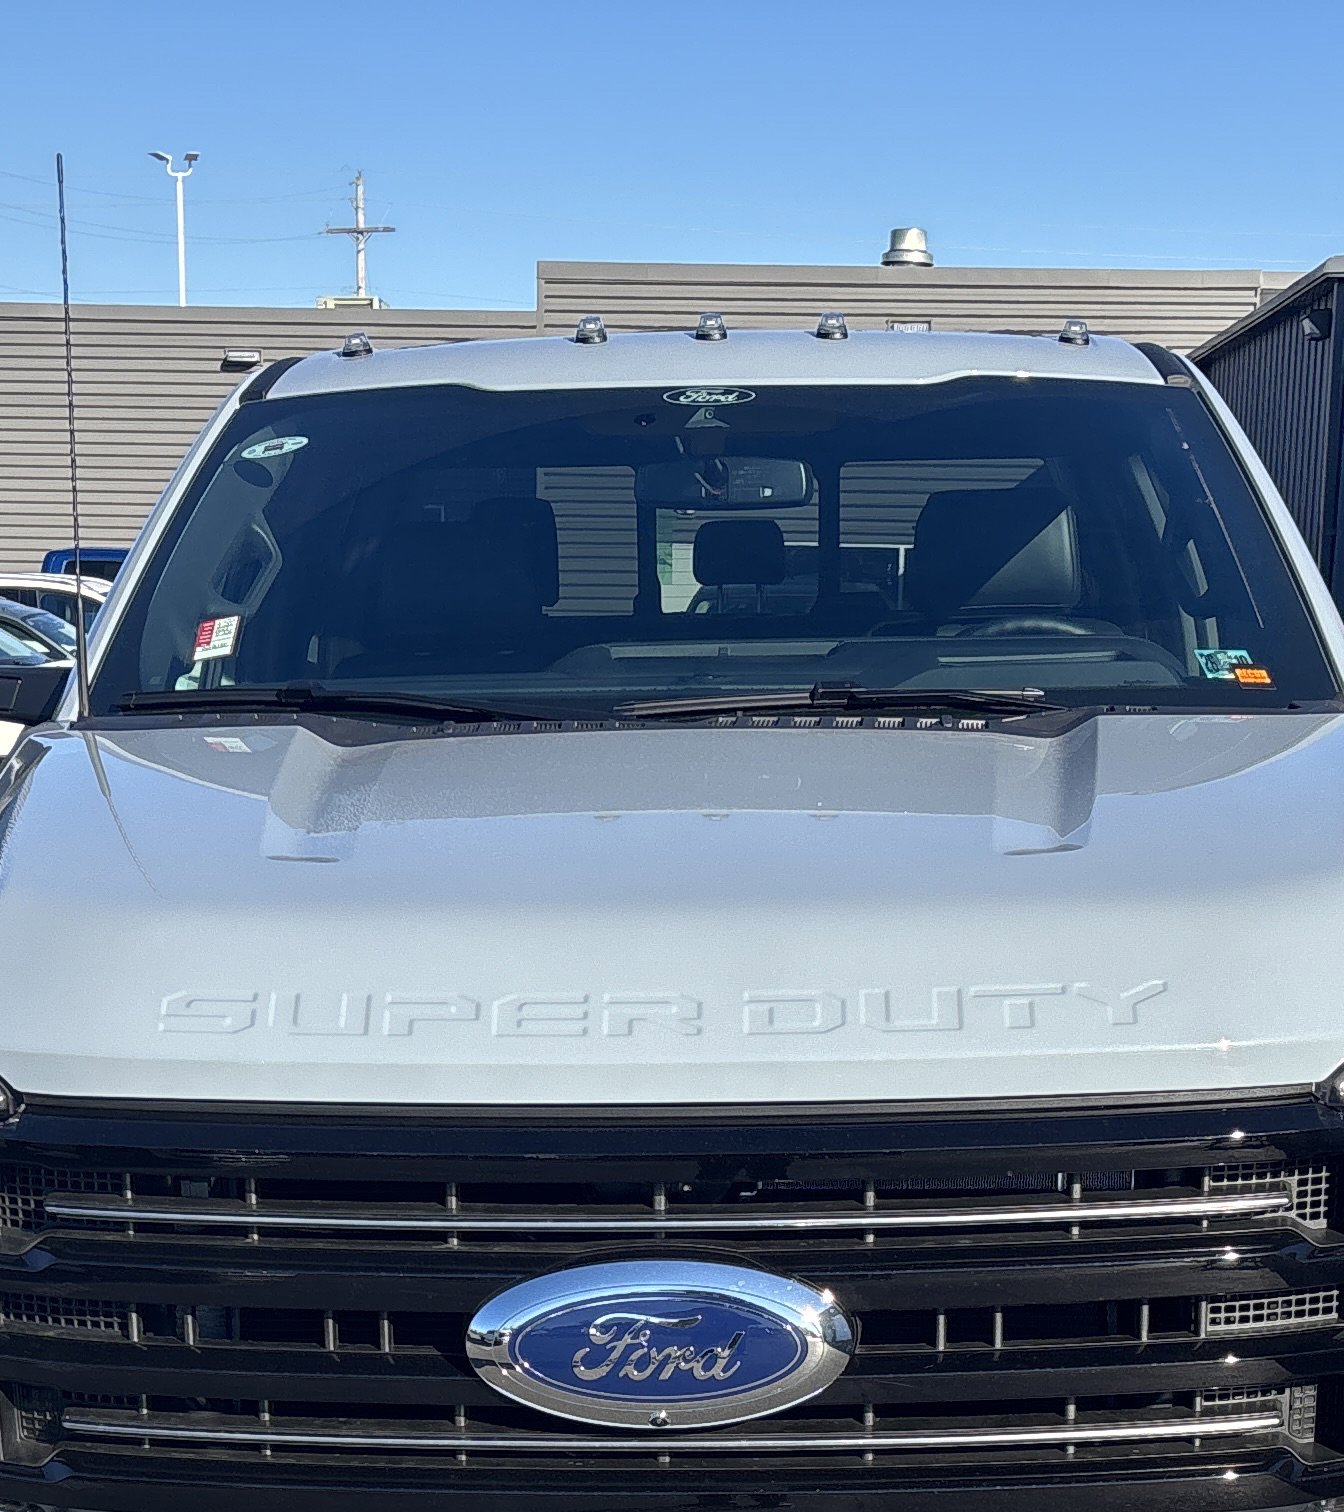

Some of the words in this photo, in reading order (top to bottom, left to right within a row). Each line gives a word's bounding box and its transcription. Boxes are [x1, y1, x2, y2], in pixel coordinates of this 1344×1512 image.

[678, 388, 740, 402] Ford
[158, 989, 702, 1037] SUPER
[742, 979, 1169, 1035] DUTY
[572, 1311, 747, 1382] Ford
